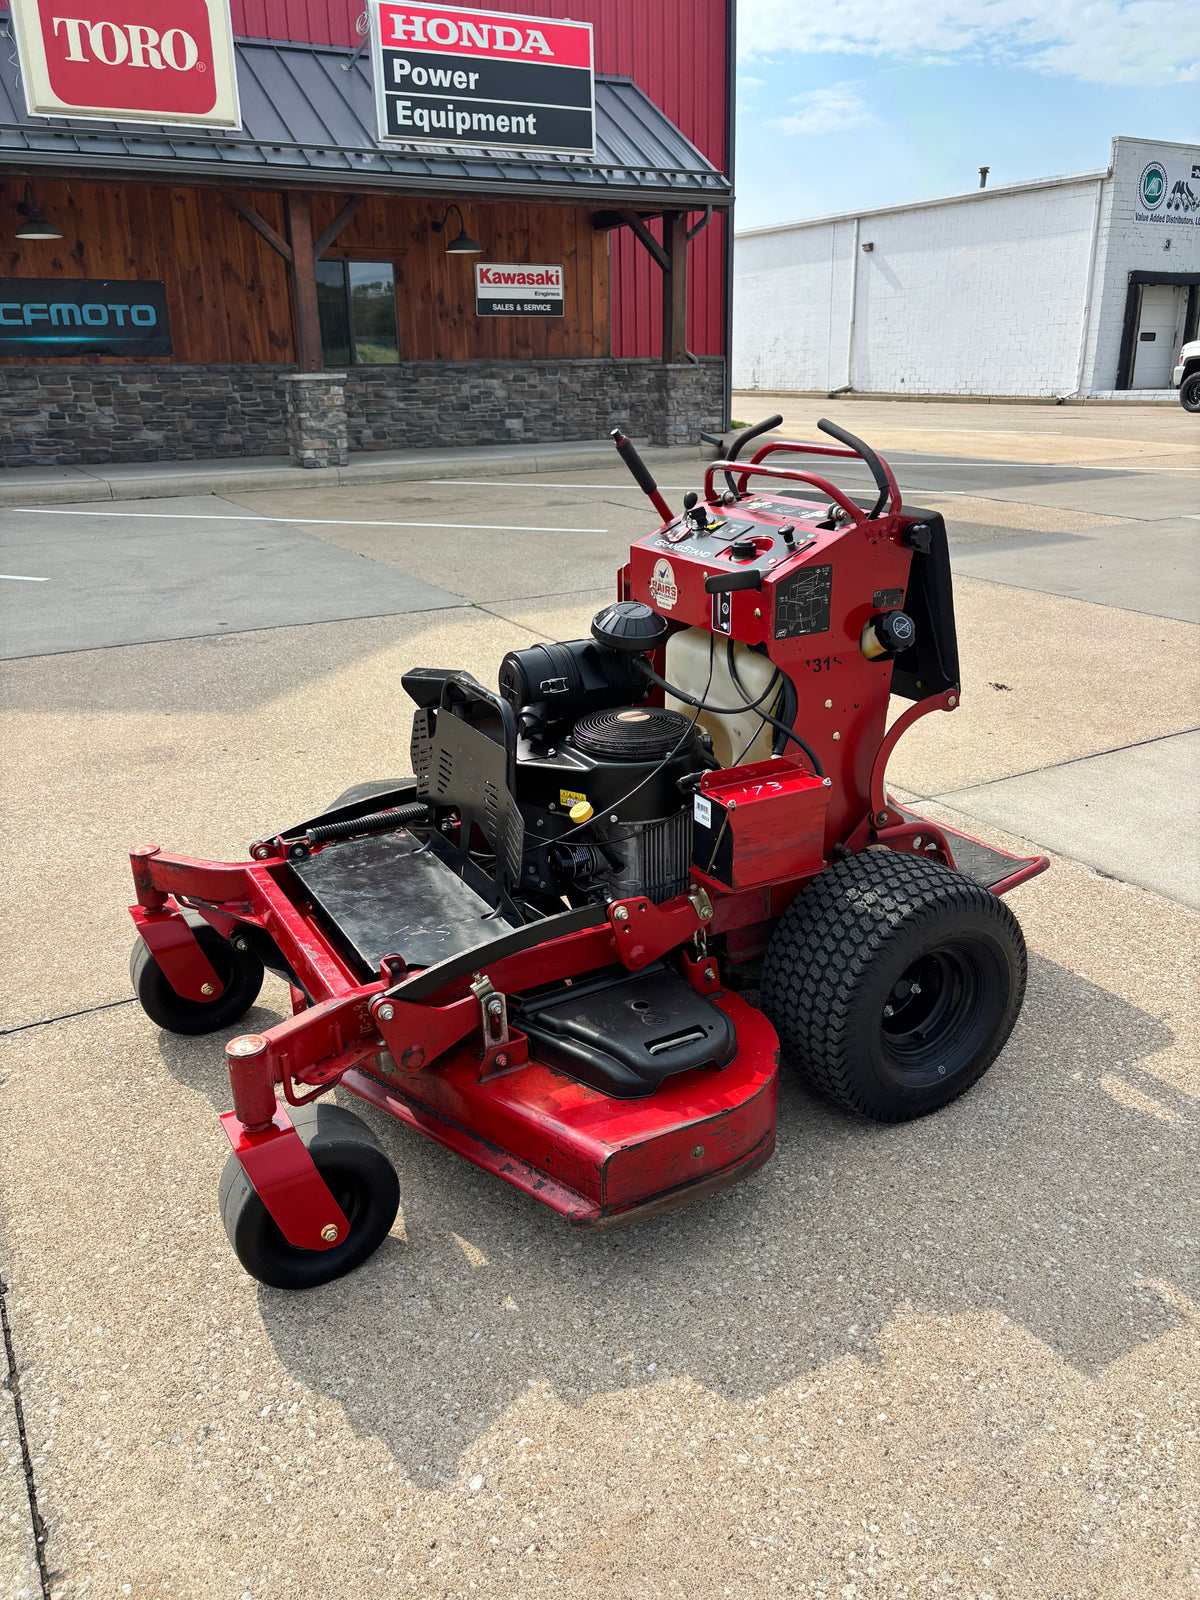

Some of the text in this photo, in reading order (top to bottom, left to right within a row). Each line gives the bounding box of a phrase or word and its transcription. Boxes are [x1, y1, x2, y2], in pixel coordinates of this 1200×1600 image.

[53, 17, 199, 71] TORO
[390, 13, 555, 56] HONDA
[393, 58, 479, 90] Power
[396, 100, 537, 135] Equipment
[1135, 213, 1149, 222] Value
[1149, 214, 1165, 223] Added
[1166, 214, 1194, 226] Distributors,
[1165, 239, 1171, 249] 3
[479, 268, 560, 286] Kawasaki
[0, 303, 157, 326] CFMOTO
[492, 303, 515, 311] SALES
